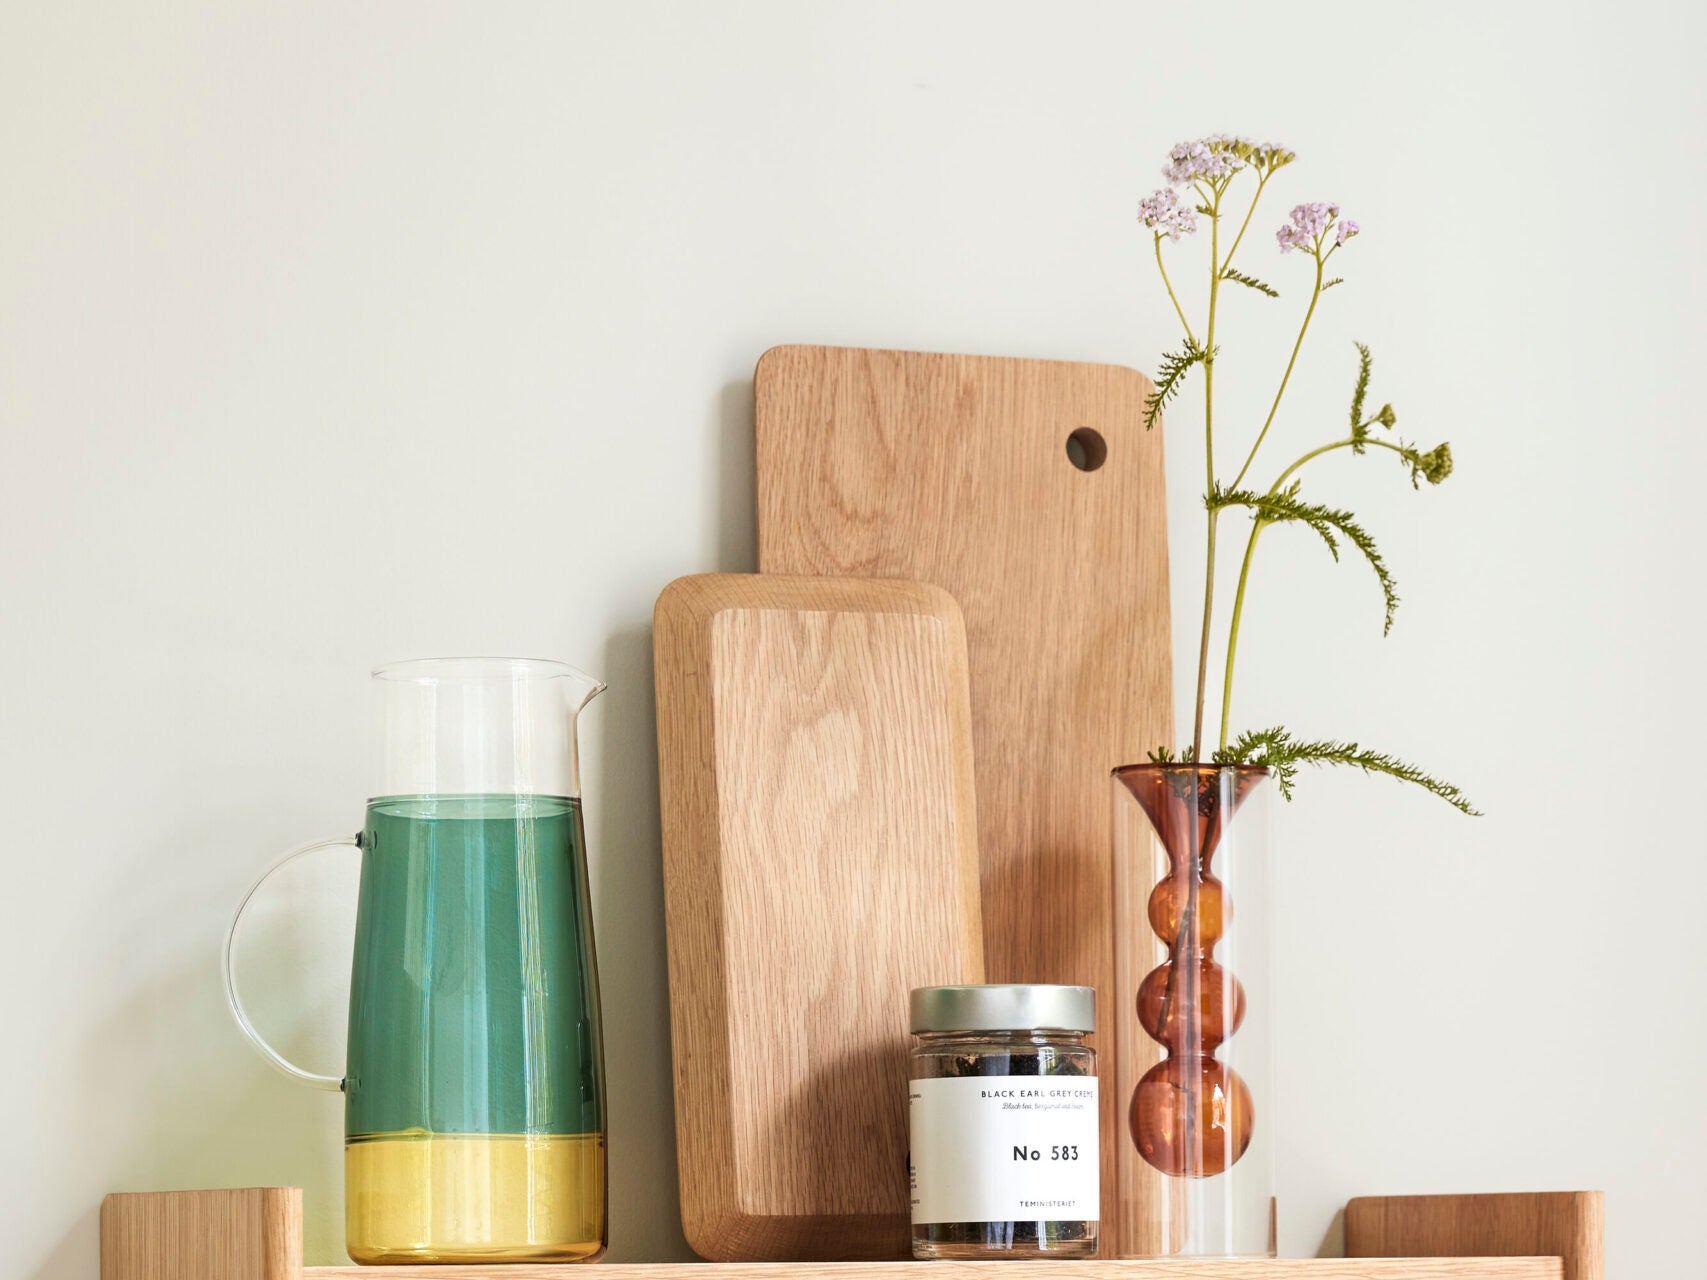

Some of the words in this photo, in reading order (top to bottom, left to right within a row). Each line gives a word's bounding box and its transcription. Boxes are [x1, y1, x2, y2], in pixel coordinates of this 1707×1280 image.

[981, 1090, 1015, 1098] BLACK
[1020, 1089, 1045, 1098] EARL
[1049, 1089, 1072, 1098] GREY
[1001, 1102, 1021, 1110] Black
[1013, 1145, 1041, 1161] No
[1051, 1145, 1078, 1161] 583
[1019, 1200, 1076, 1208] TEMINISTERIET
